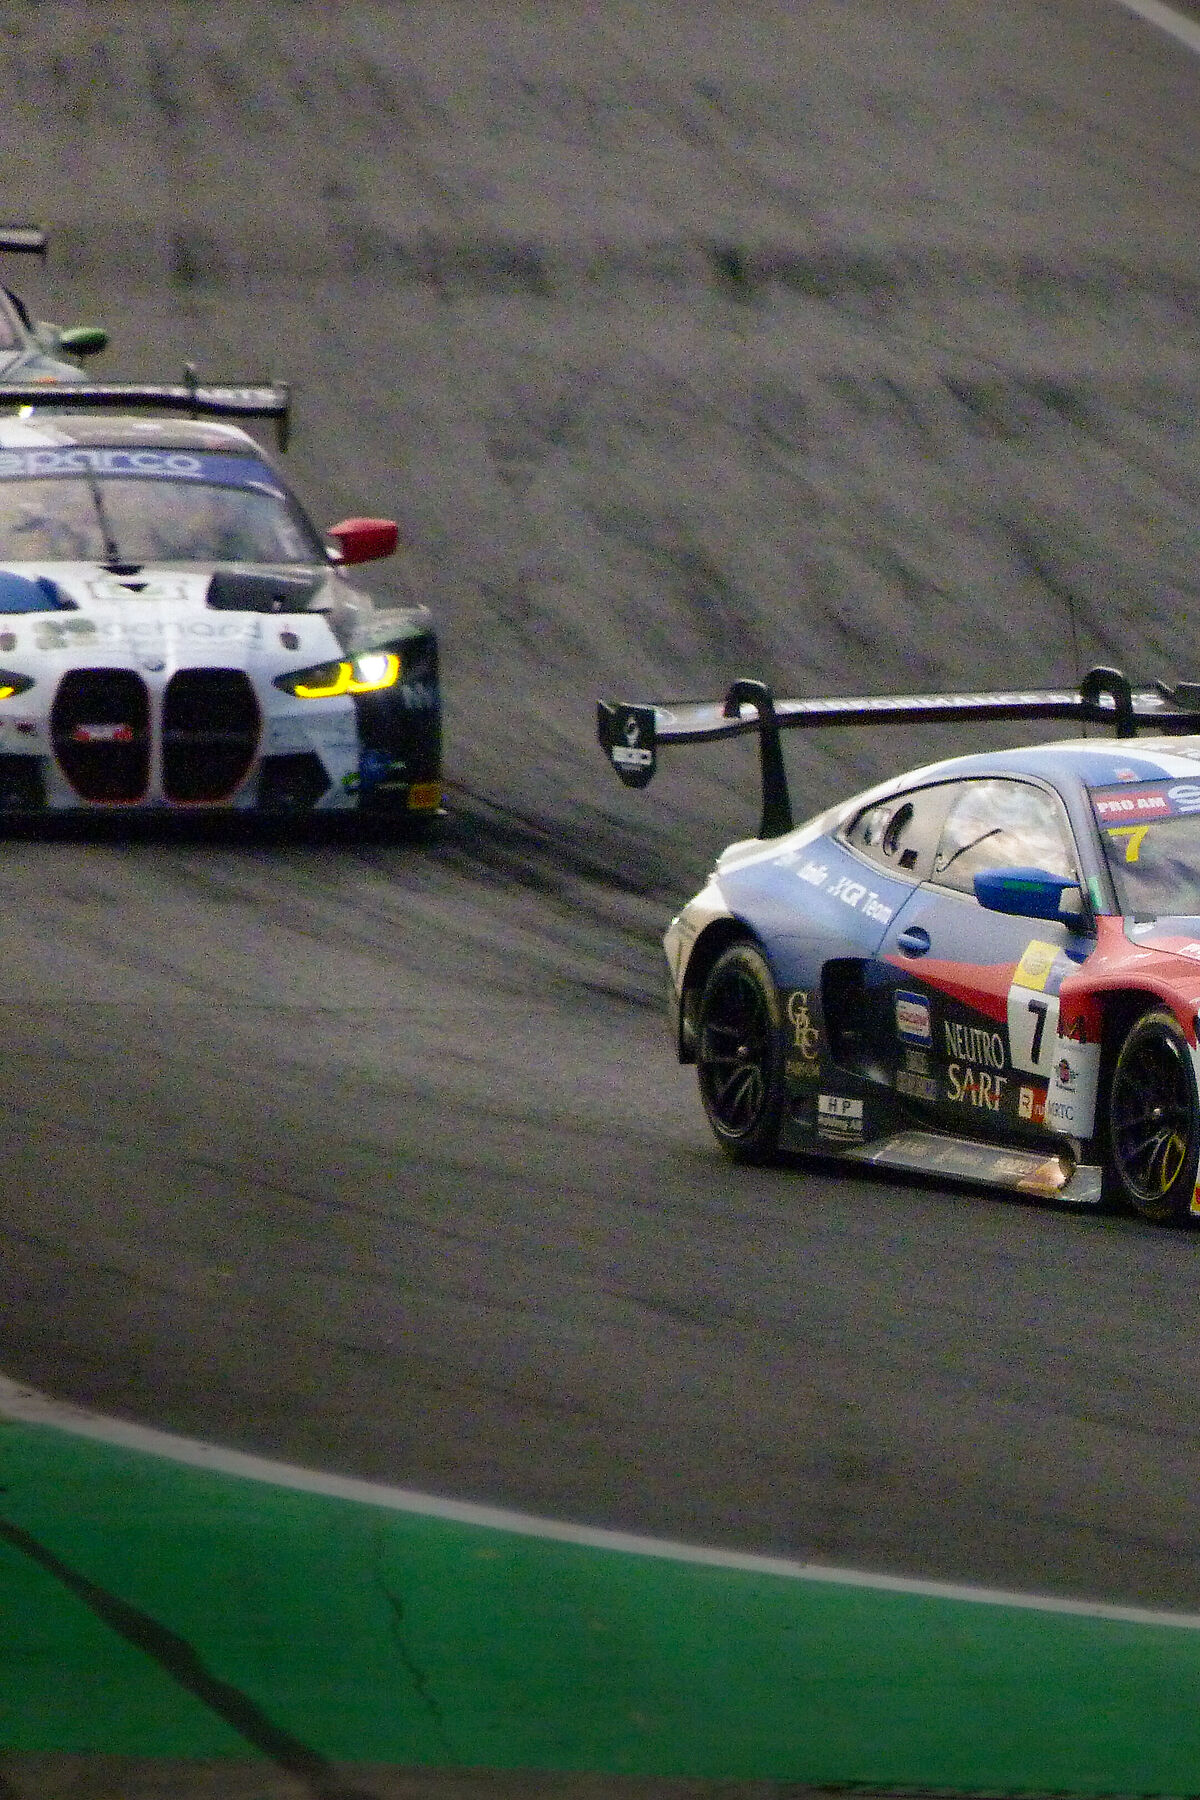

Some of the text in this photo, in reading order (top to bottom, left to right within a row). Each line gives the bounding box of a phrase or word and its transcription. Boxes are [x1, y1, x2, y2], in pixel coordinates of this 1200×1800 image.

[1096, 797, 1166, 813] PRO AM
[1107, 826, 1150, 862] 7
[944, 1020, 1005, 1069] NEUTRO
[1028, 999, 1048, 1064] 7
